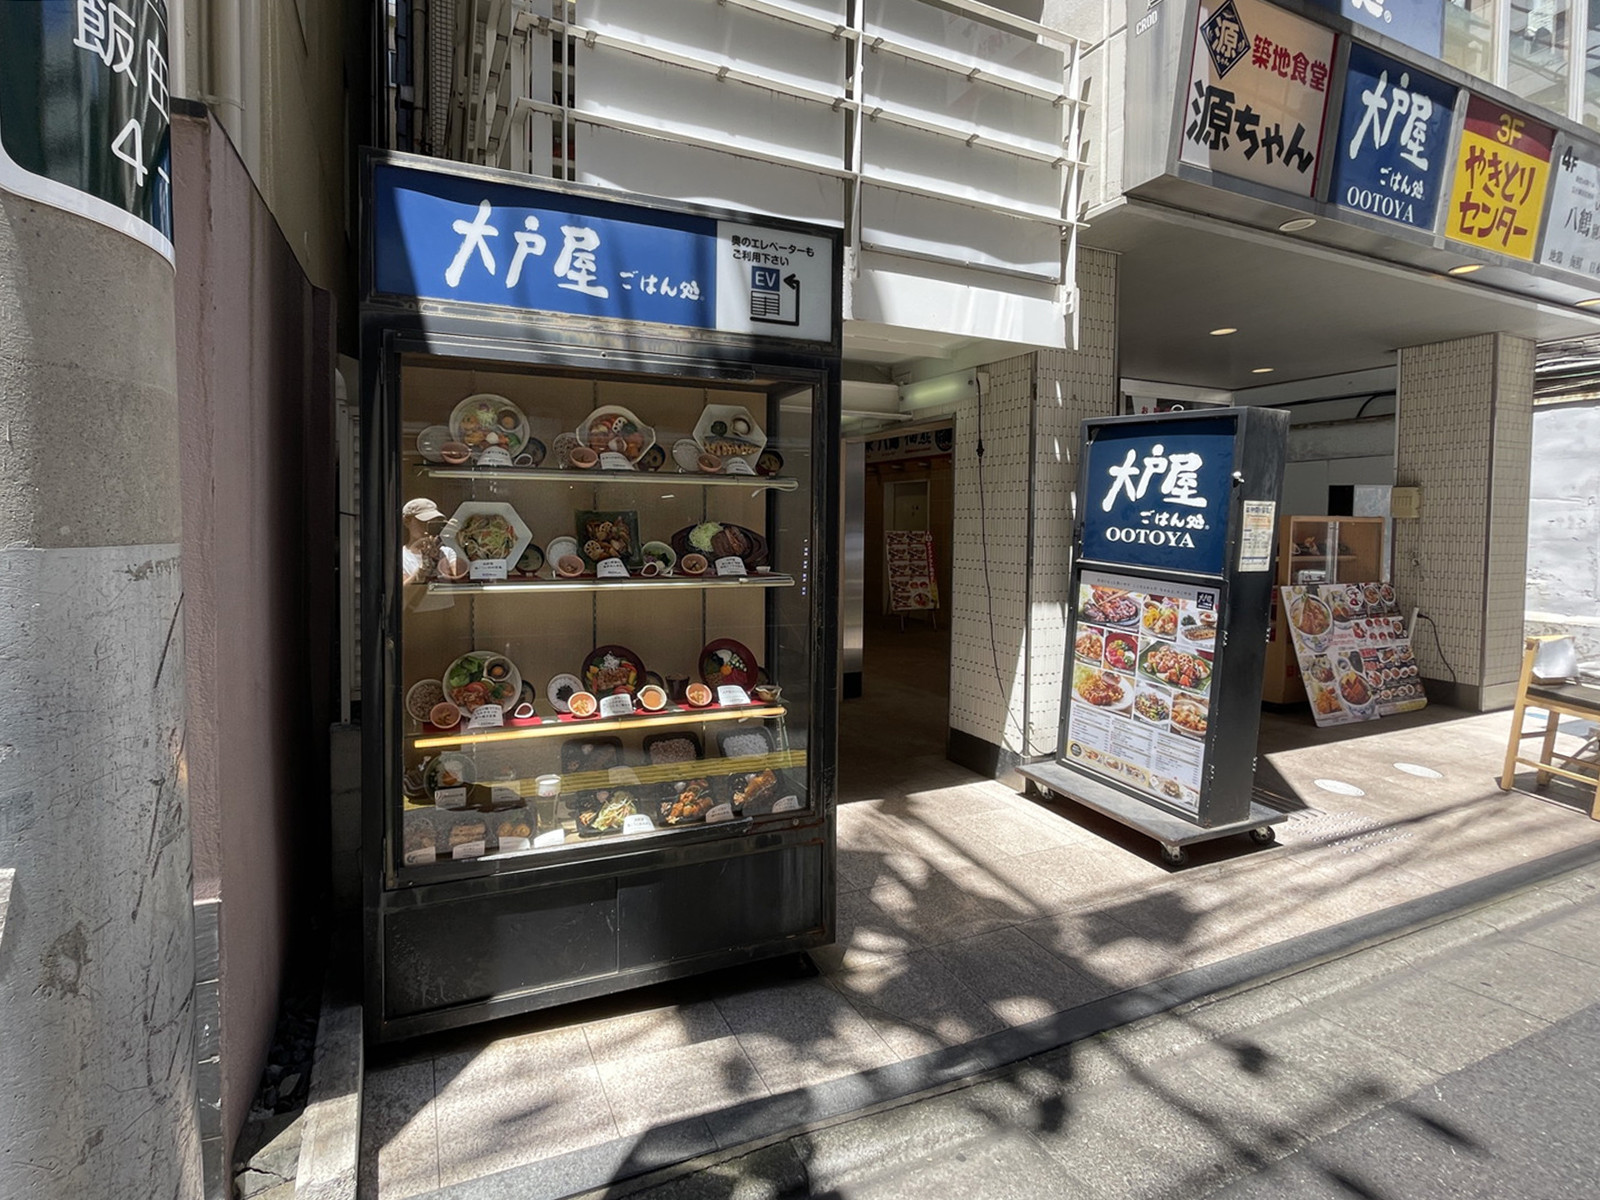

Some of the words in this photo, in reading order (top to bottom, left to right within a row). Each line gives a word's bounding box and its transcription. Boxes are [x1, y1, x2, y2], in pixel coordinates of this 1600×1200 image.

[1212, 16, 1239, 58] 源
[1251, 34, 1328, 92] 築地食堂
[1186, 79, 1315, 174] 源ちゃん
[1349, 69, 1432, 171] 大戸屋
[1496, 113, 1525, 146] 3F
[1465, 145, 1536, 206] やきとり
[1561, 145, 1579, 173] 4F
[1380, 167, 1424, 199] ごはん処
[1347, 186, 1414, 223] OOTOYA
[1459, 192, 1528, 247] センター
[445, 199, 609, 298] 大戸屋
[732, 235, 814, 257] 奥のエレベーターも
[733, 249, 789, 266] ご利用下さい
[619, 269, 702, 302] ごはん処
[755, 271, 776, 287] EV
[1102, 444, 1208, 512] 大戸屋
[1106, 526, 1195, 549] OOTOYA
[1139, 510, 1206, 530] ごはん処
